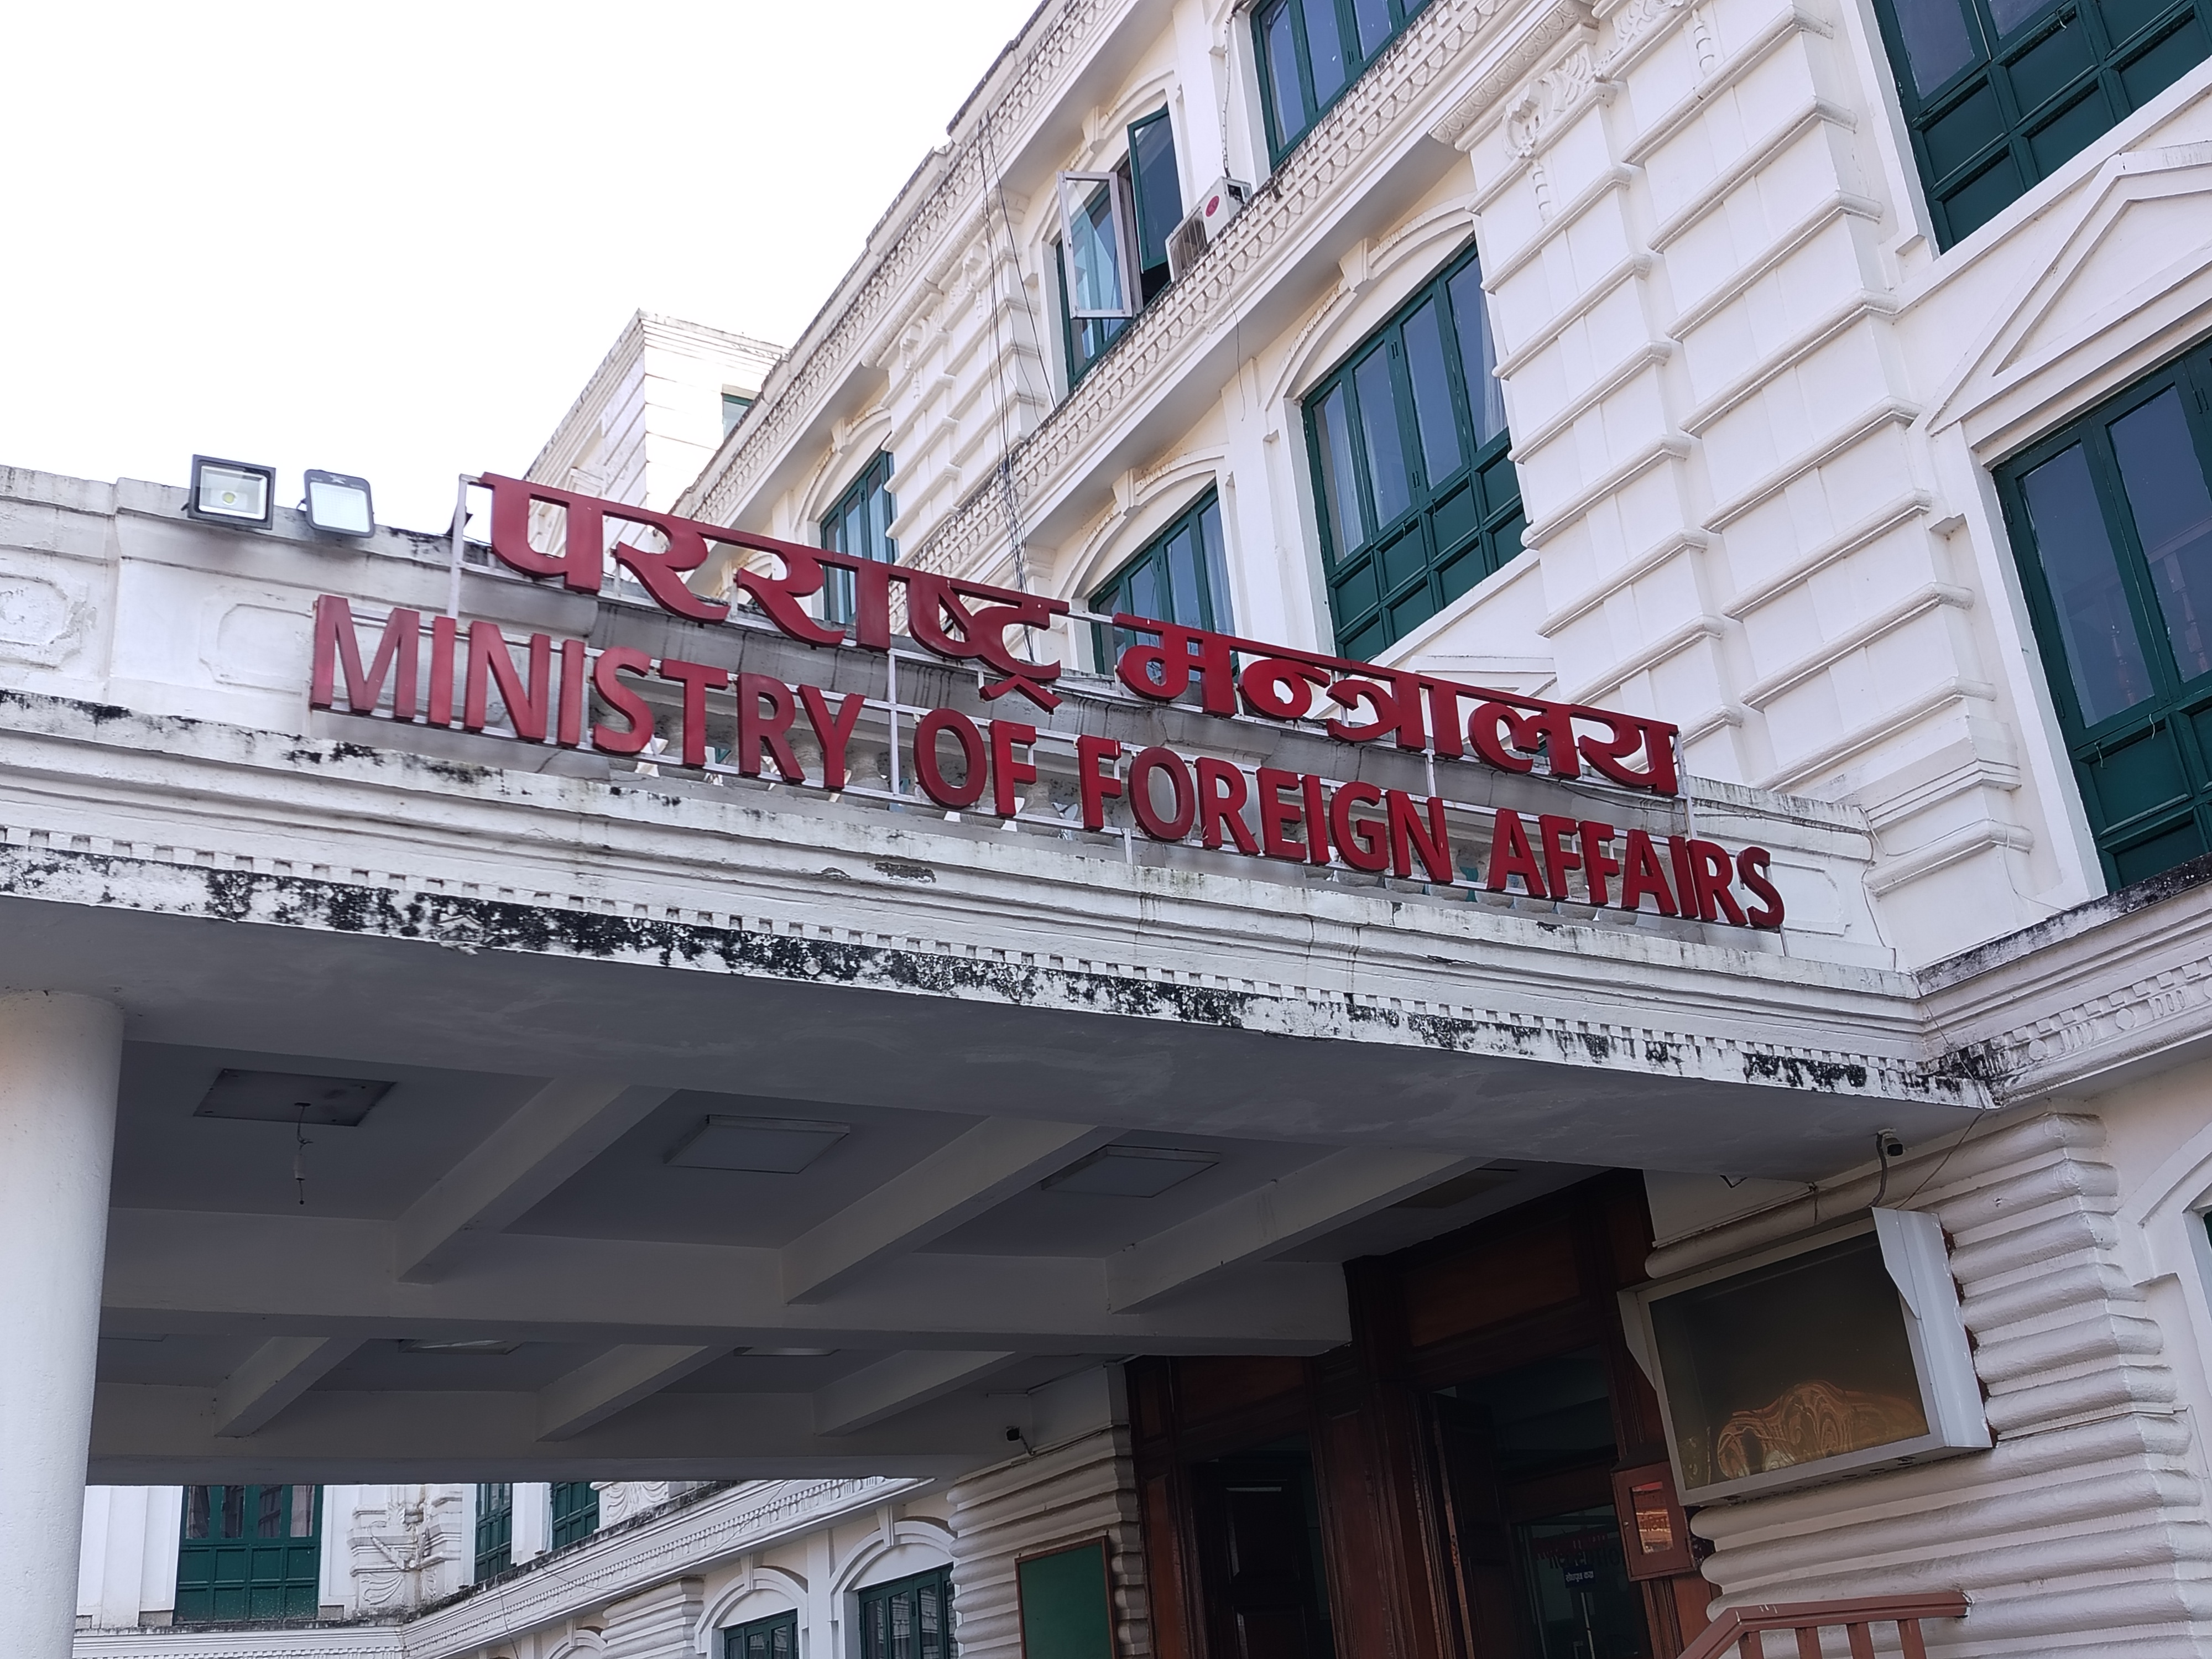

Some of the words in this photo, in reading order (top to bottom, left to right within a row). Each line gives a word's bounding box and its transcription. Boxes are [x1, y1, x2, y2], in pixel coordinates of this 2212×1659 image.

[311, 594, 866, 792] MINISTRY
[914, 707, 1037, 819] OF
[1076, 734, 1454, 885] FOREIGN
[1486, 807, 1785, 930] AFFAIRS
[481, 472, 1070, 713] परराष्ट्र
[1113, 612, 1679, 797] मन्त्रालय
